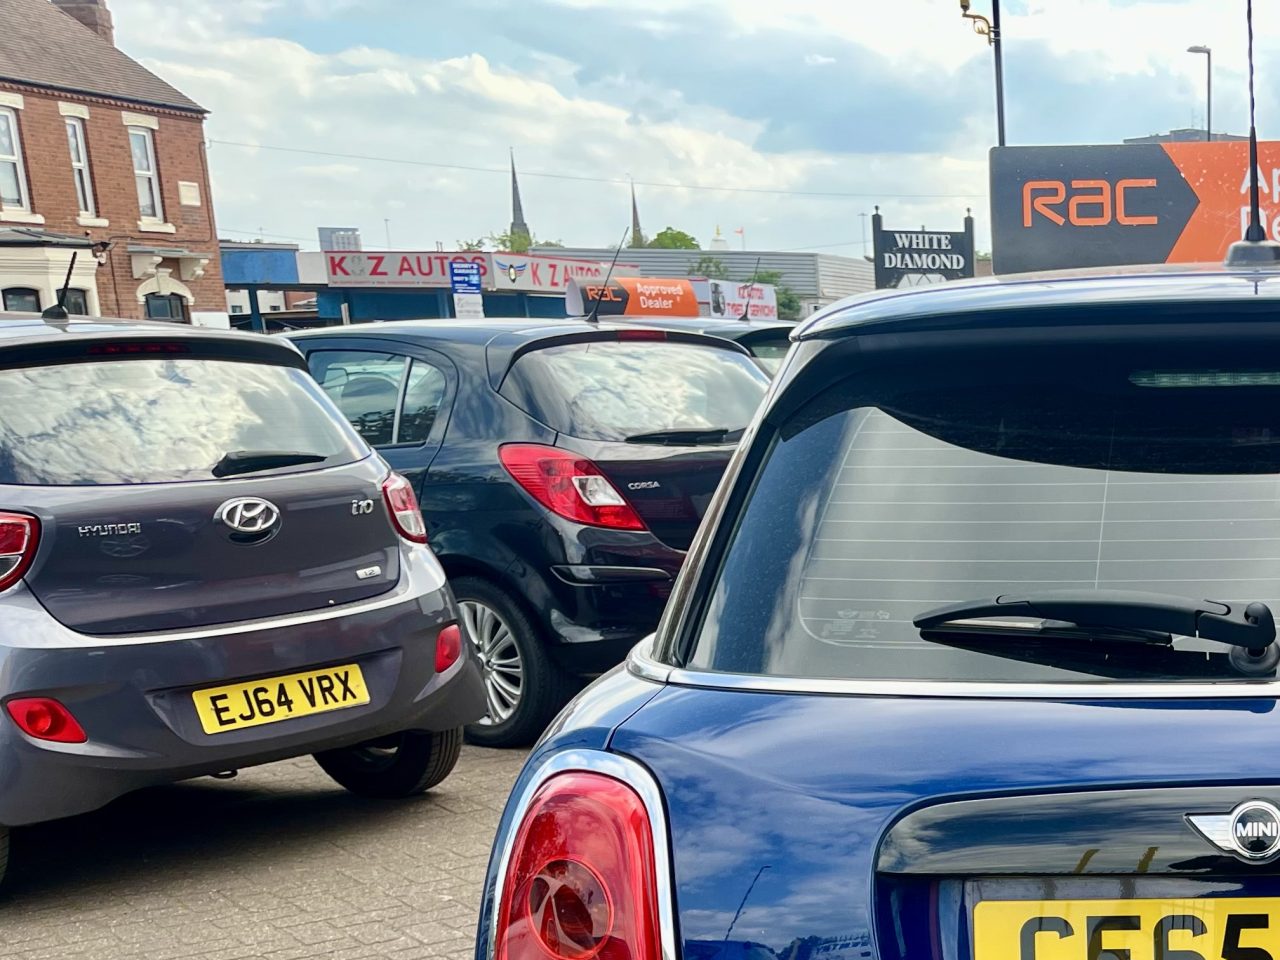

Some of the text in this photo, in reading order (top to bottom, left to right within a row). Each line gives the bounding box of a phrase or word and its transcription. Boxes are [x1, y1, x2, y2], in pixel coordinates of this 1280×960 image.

[894, 233, 951, 249] WHITE
[884, 253, 965, 269] DIAMOND
[637, 283, 684, 296] Approved
[640, 296, 673, 308] Dealer
[628, 481, 660, 490] CORSA
[352, 500, 374, 515] i10
[78, 522, 141, 537] HYUNDAI
[210, 671, 357, 726] EJ64 VRX
[1236, 821, 1278, 837] MINI
